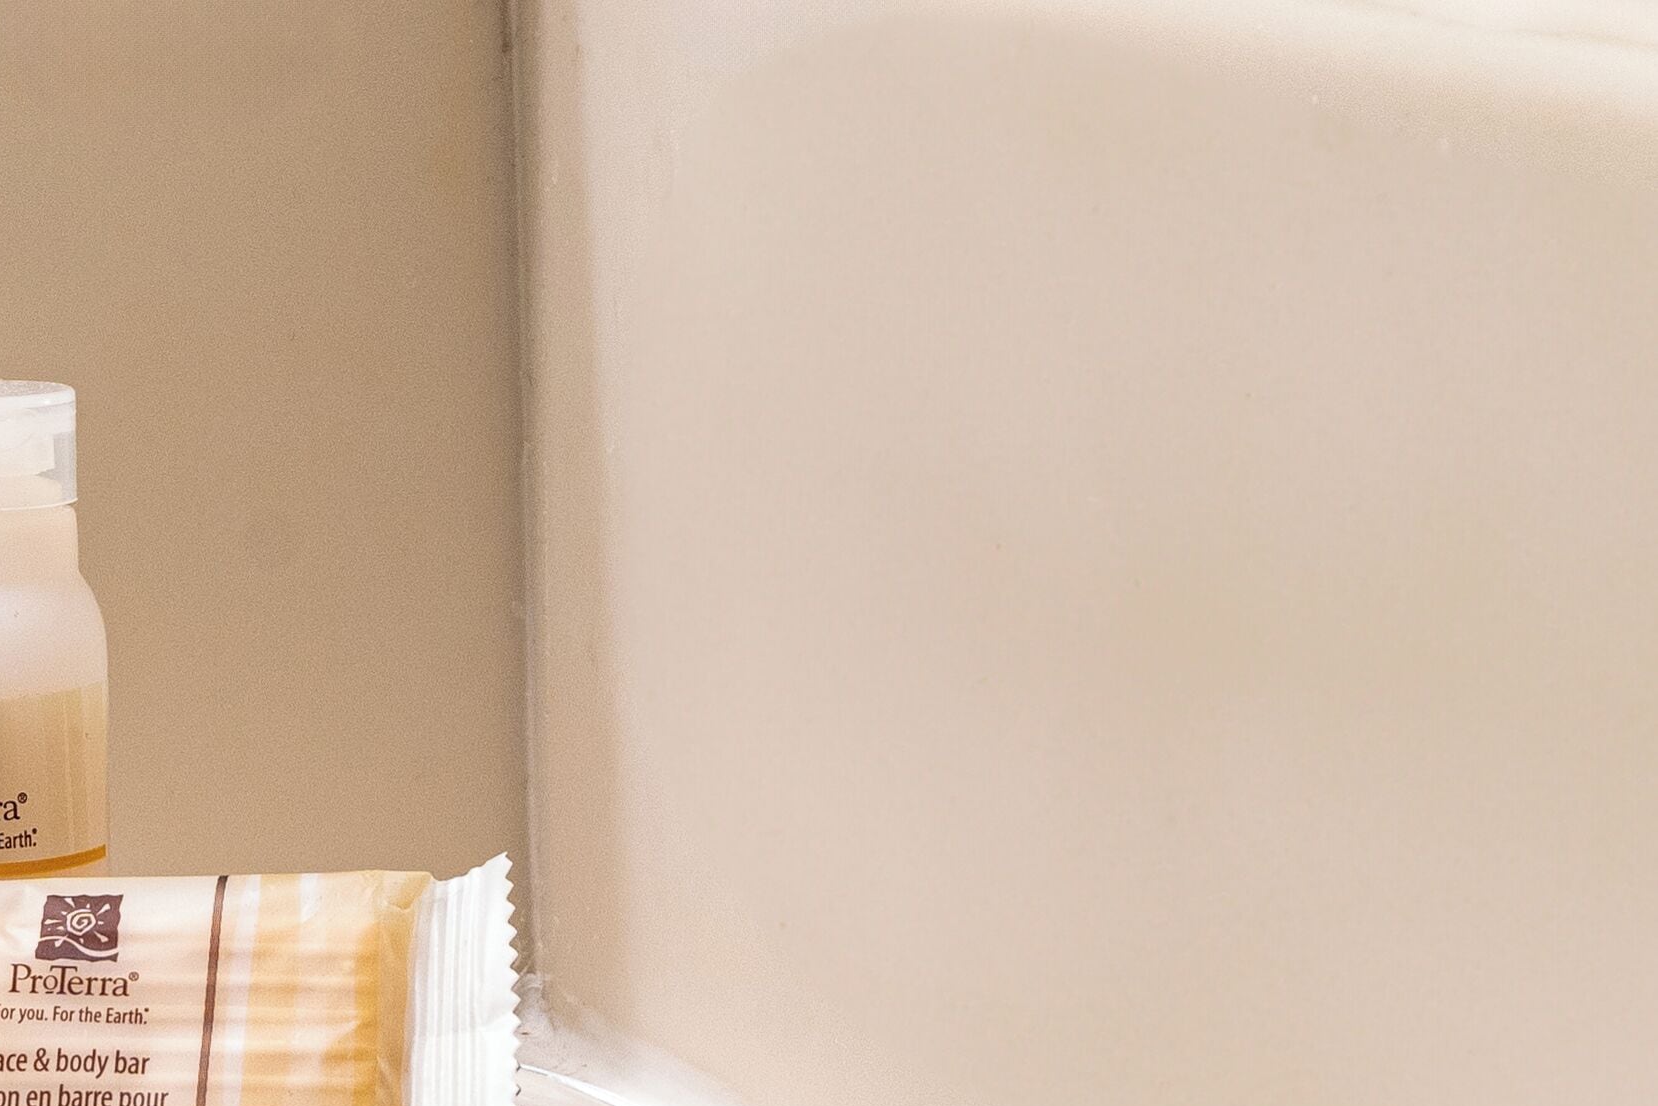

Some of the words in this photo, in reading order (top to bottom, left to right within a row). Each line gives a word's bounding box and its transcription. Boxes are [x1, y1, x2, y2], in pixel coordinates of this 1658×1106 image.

[18, 1007, 48, 1024] you.
[52, 1006, 75, 1022] For
[79, 1006, 102, 1023] the
[33, 1048, 50, 1072] &
[55, 1048, 109, 1079] body
[114, 1050, 150, 1075] bar
